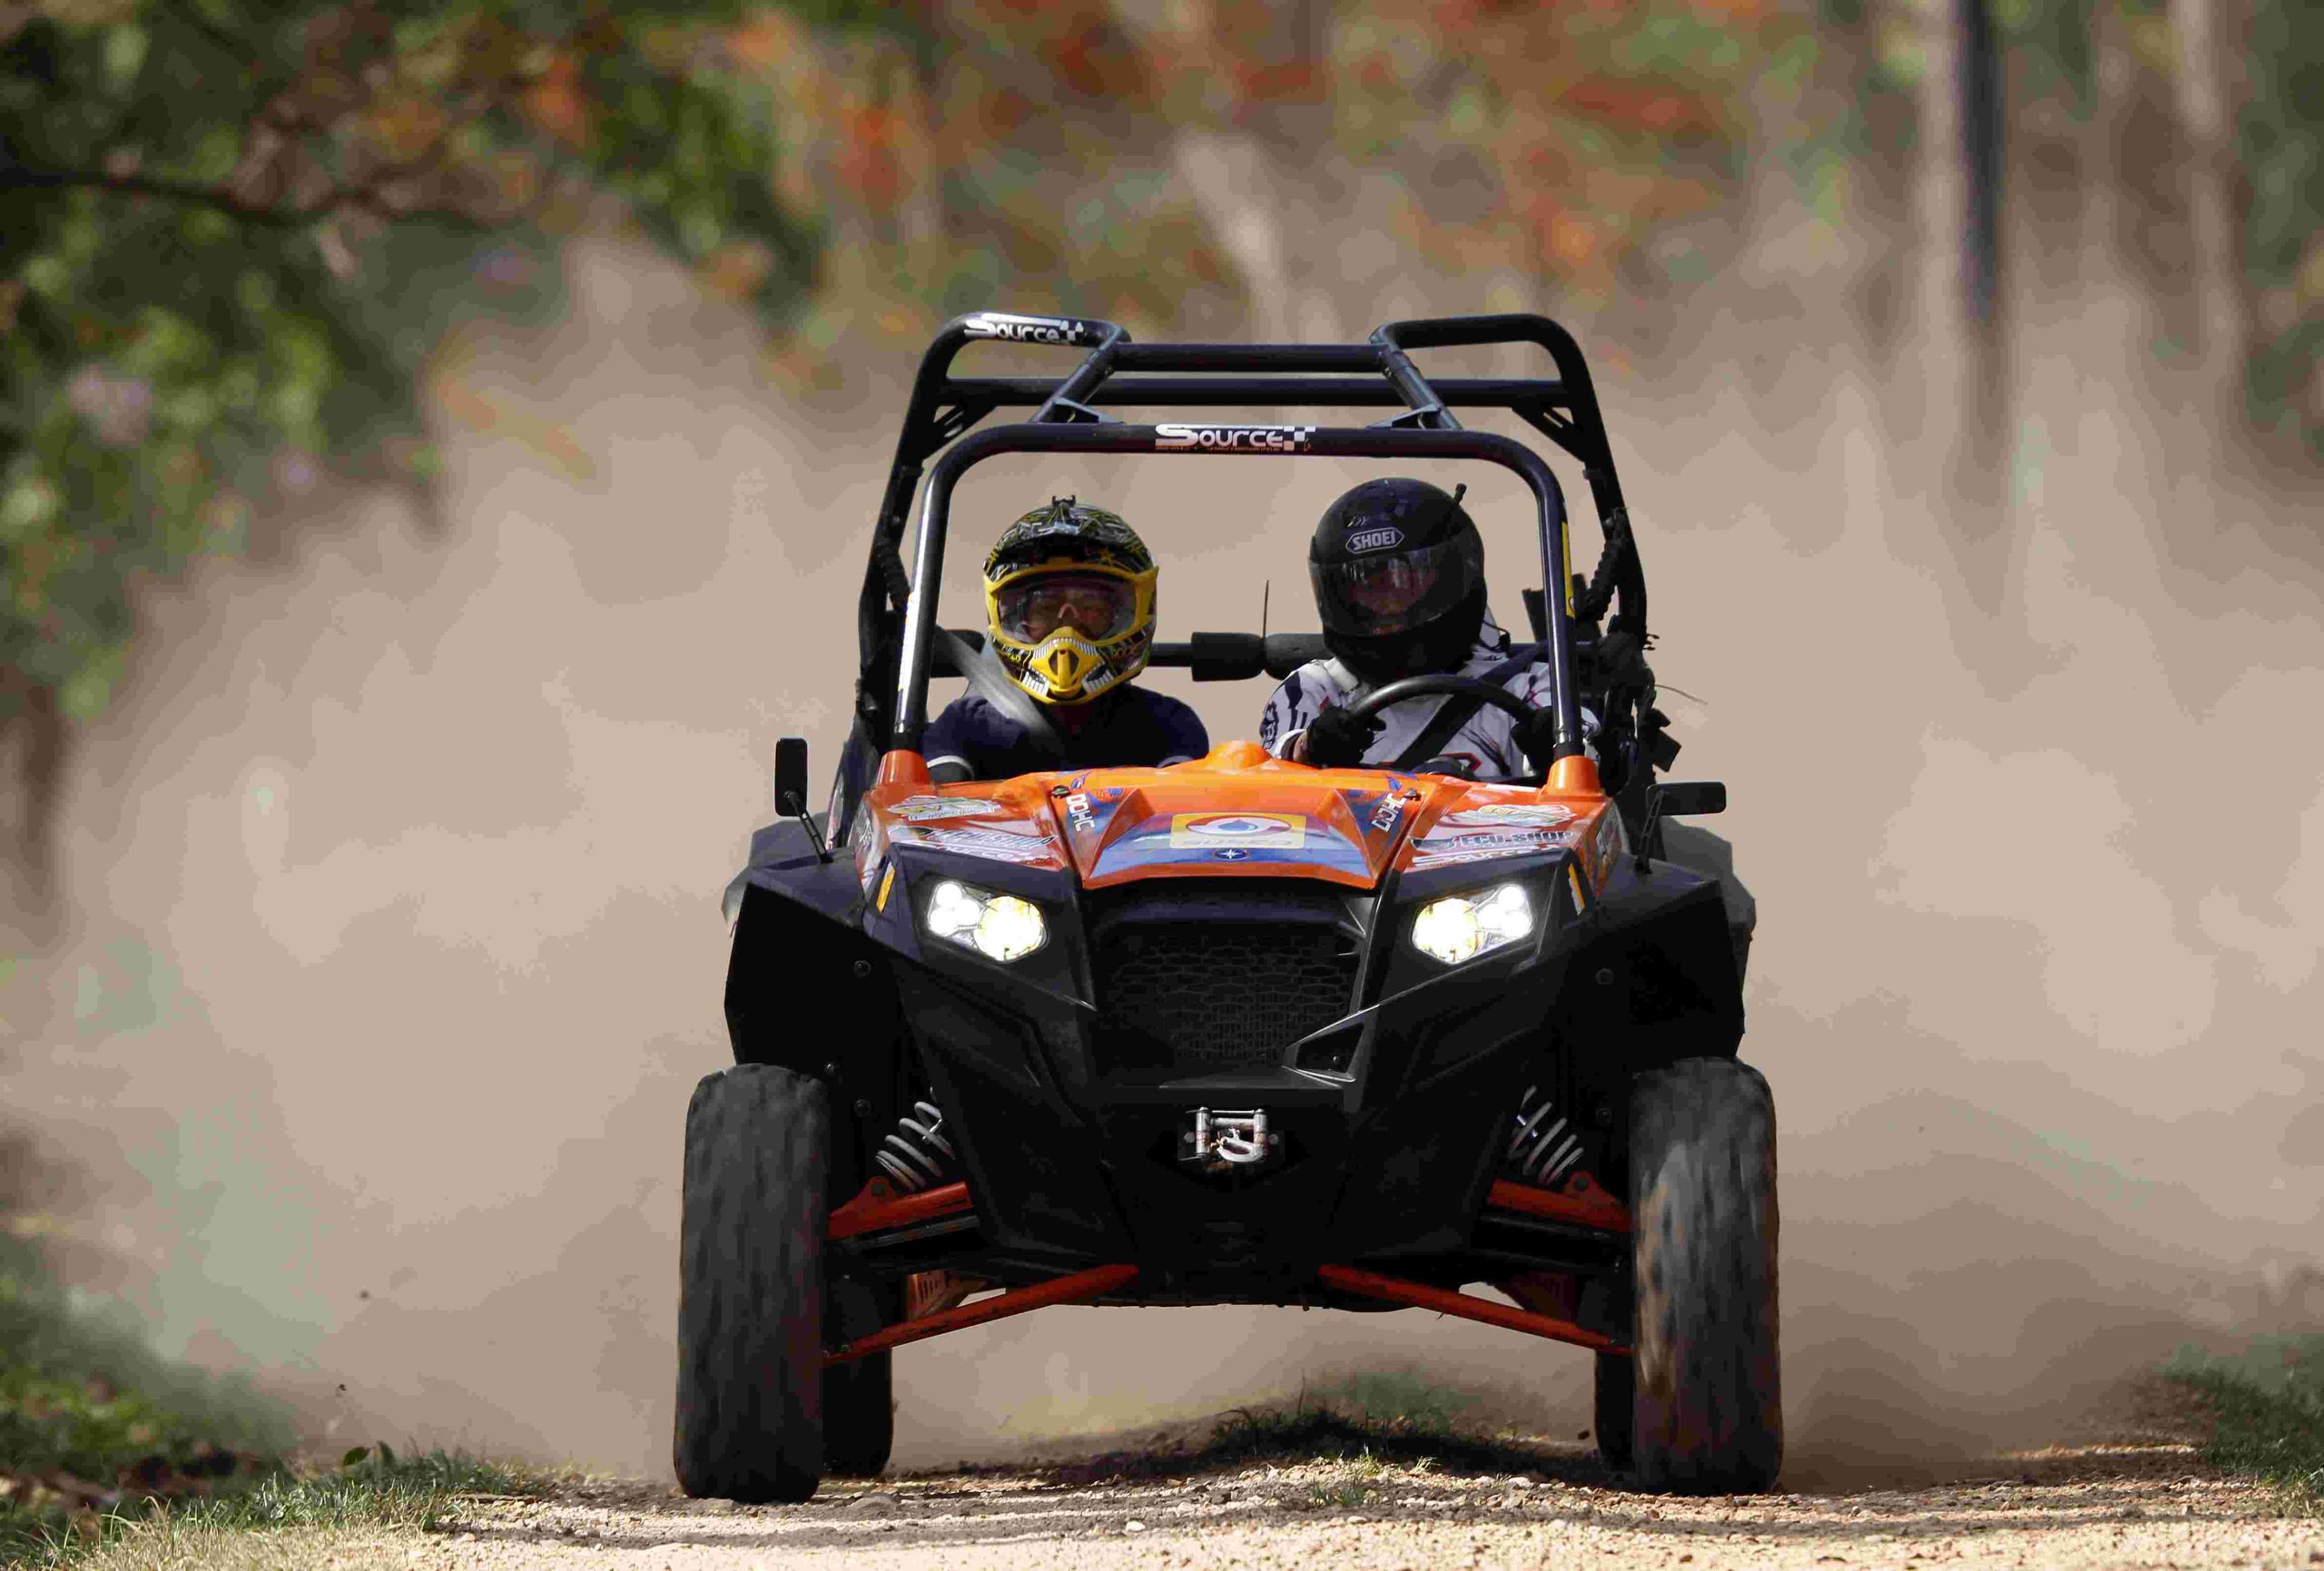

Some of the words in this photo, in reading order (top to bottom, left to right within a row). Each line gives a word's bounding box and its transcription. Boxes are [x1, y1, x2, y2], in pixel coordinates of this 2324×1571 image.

[964, 312, 1061, 342] Source
[1156, 424, 1283, 447] Source
[1352, 531, 1396, 550] SHOEI
[1066, 793, 1095, 832] DOHC
[1372, 792, 1406, 832] DOHC
